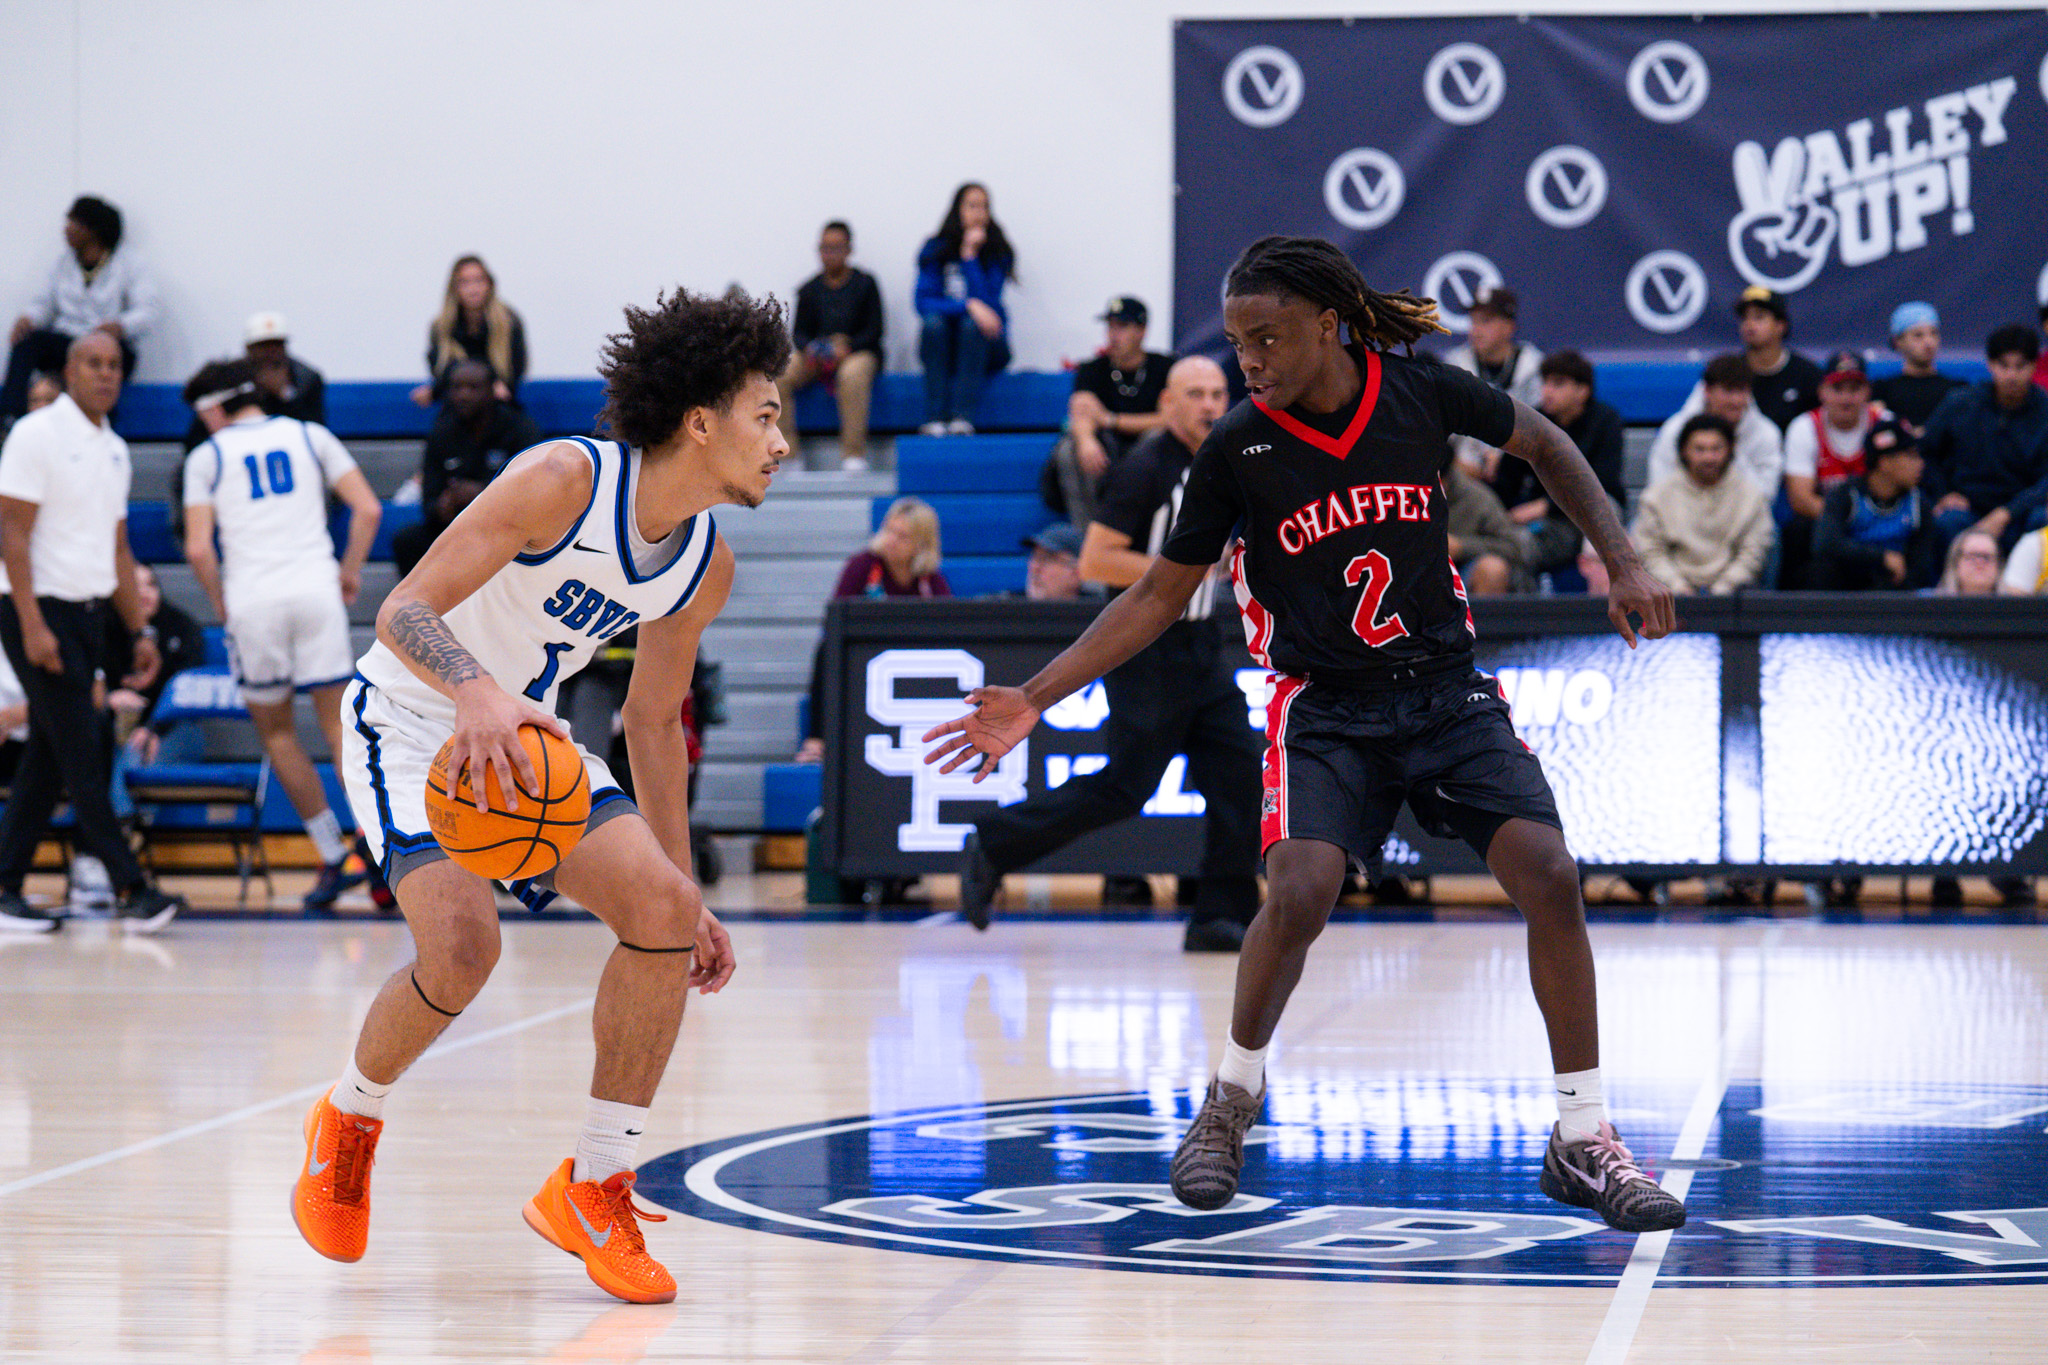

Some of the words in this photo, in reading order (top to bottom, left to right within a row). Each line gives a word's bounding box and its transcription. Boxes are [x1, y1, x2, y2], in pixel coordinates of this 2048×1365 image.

[1731, 74, 2018, 212] VALLEY
[1832, 152, 1976, 268] UP!
[244, 450, 294, 499] 10
[1277, 483, 1433, 556] CHAFFEY
[543, 579, 640, 640] SBVC
[1343, 549, 1410, 648] 2
[522, 641, 576, 702] 1
